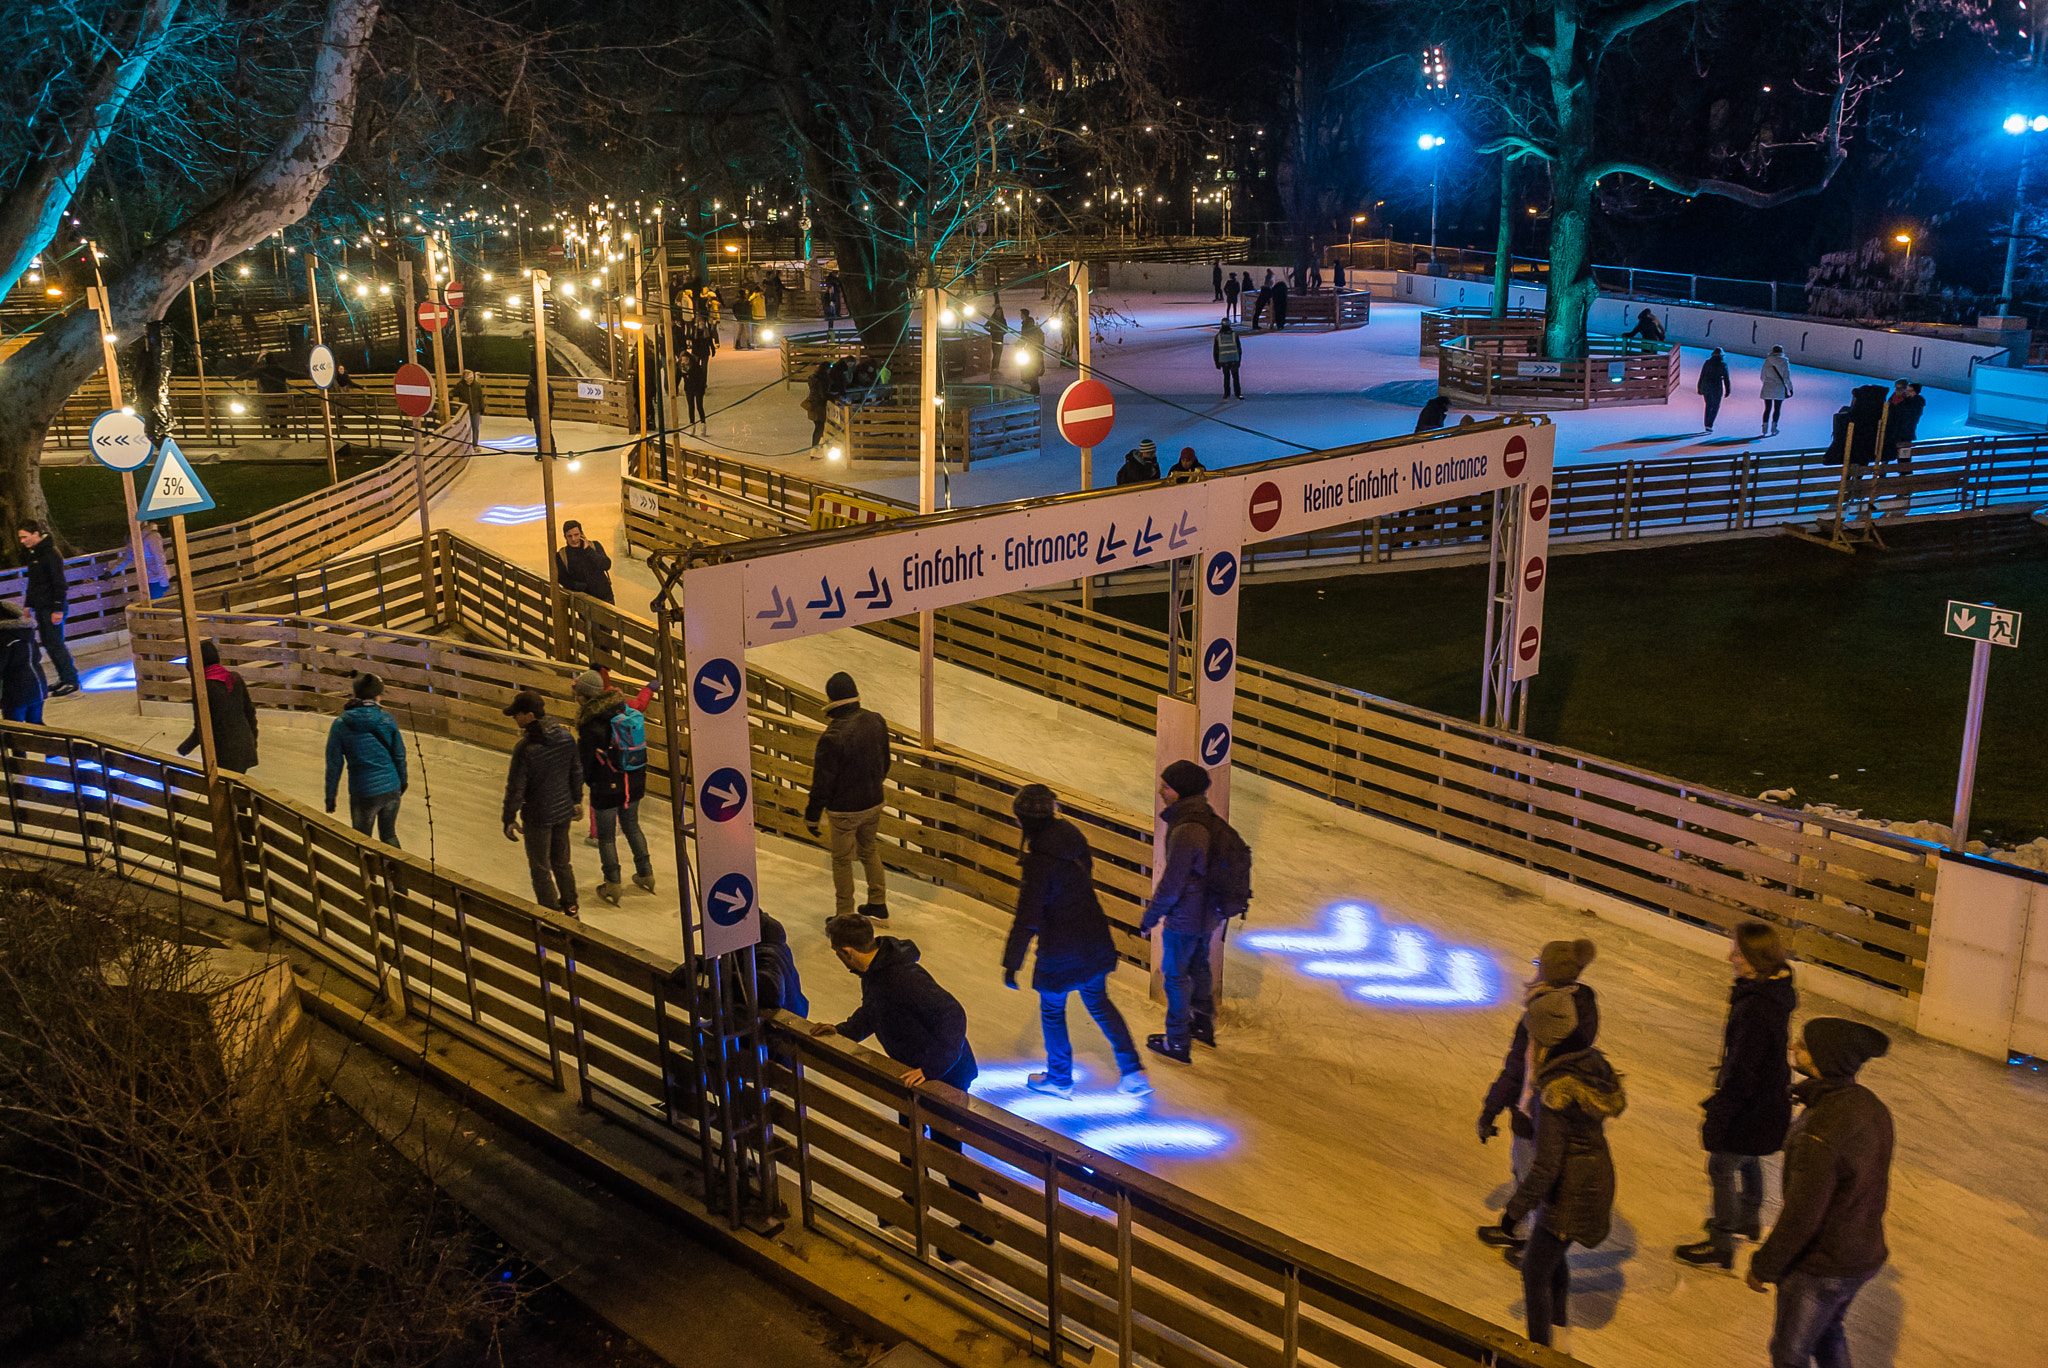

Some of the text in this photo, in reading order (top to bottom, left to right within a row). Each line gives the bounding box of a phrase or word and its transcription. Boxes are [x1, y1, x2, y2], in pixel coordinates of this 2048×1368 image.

[163, 477, 184, 496] 3%
[1303, 479, 1344, 514] Keine
[1348, 467, 1399, 504] Einfahrt
[1411, 461, 1432, 491] No
[1435, 455, 1488, 485] entrance
[903, 544, 984, 592] Einfahrt
[1004, 530, 1089, 572] Entrance
